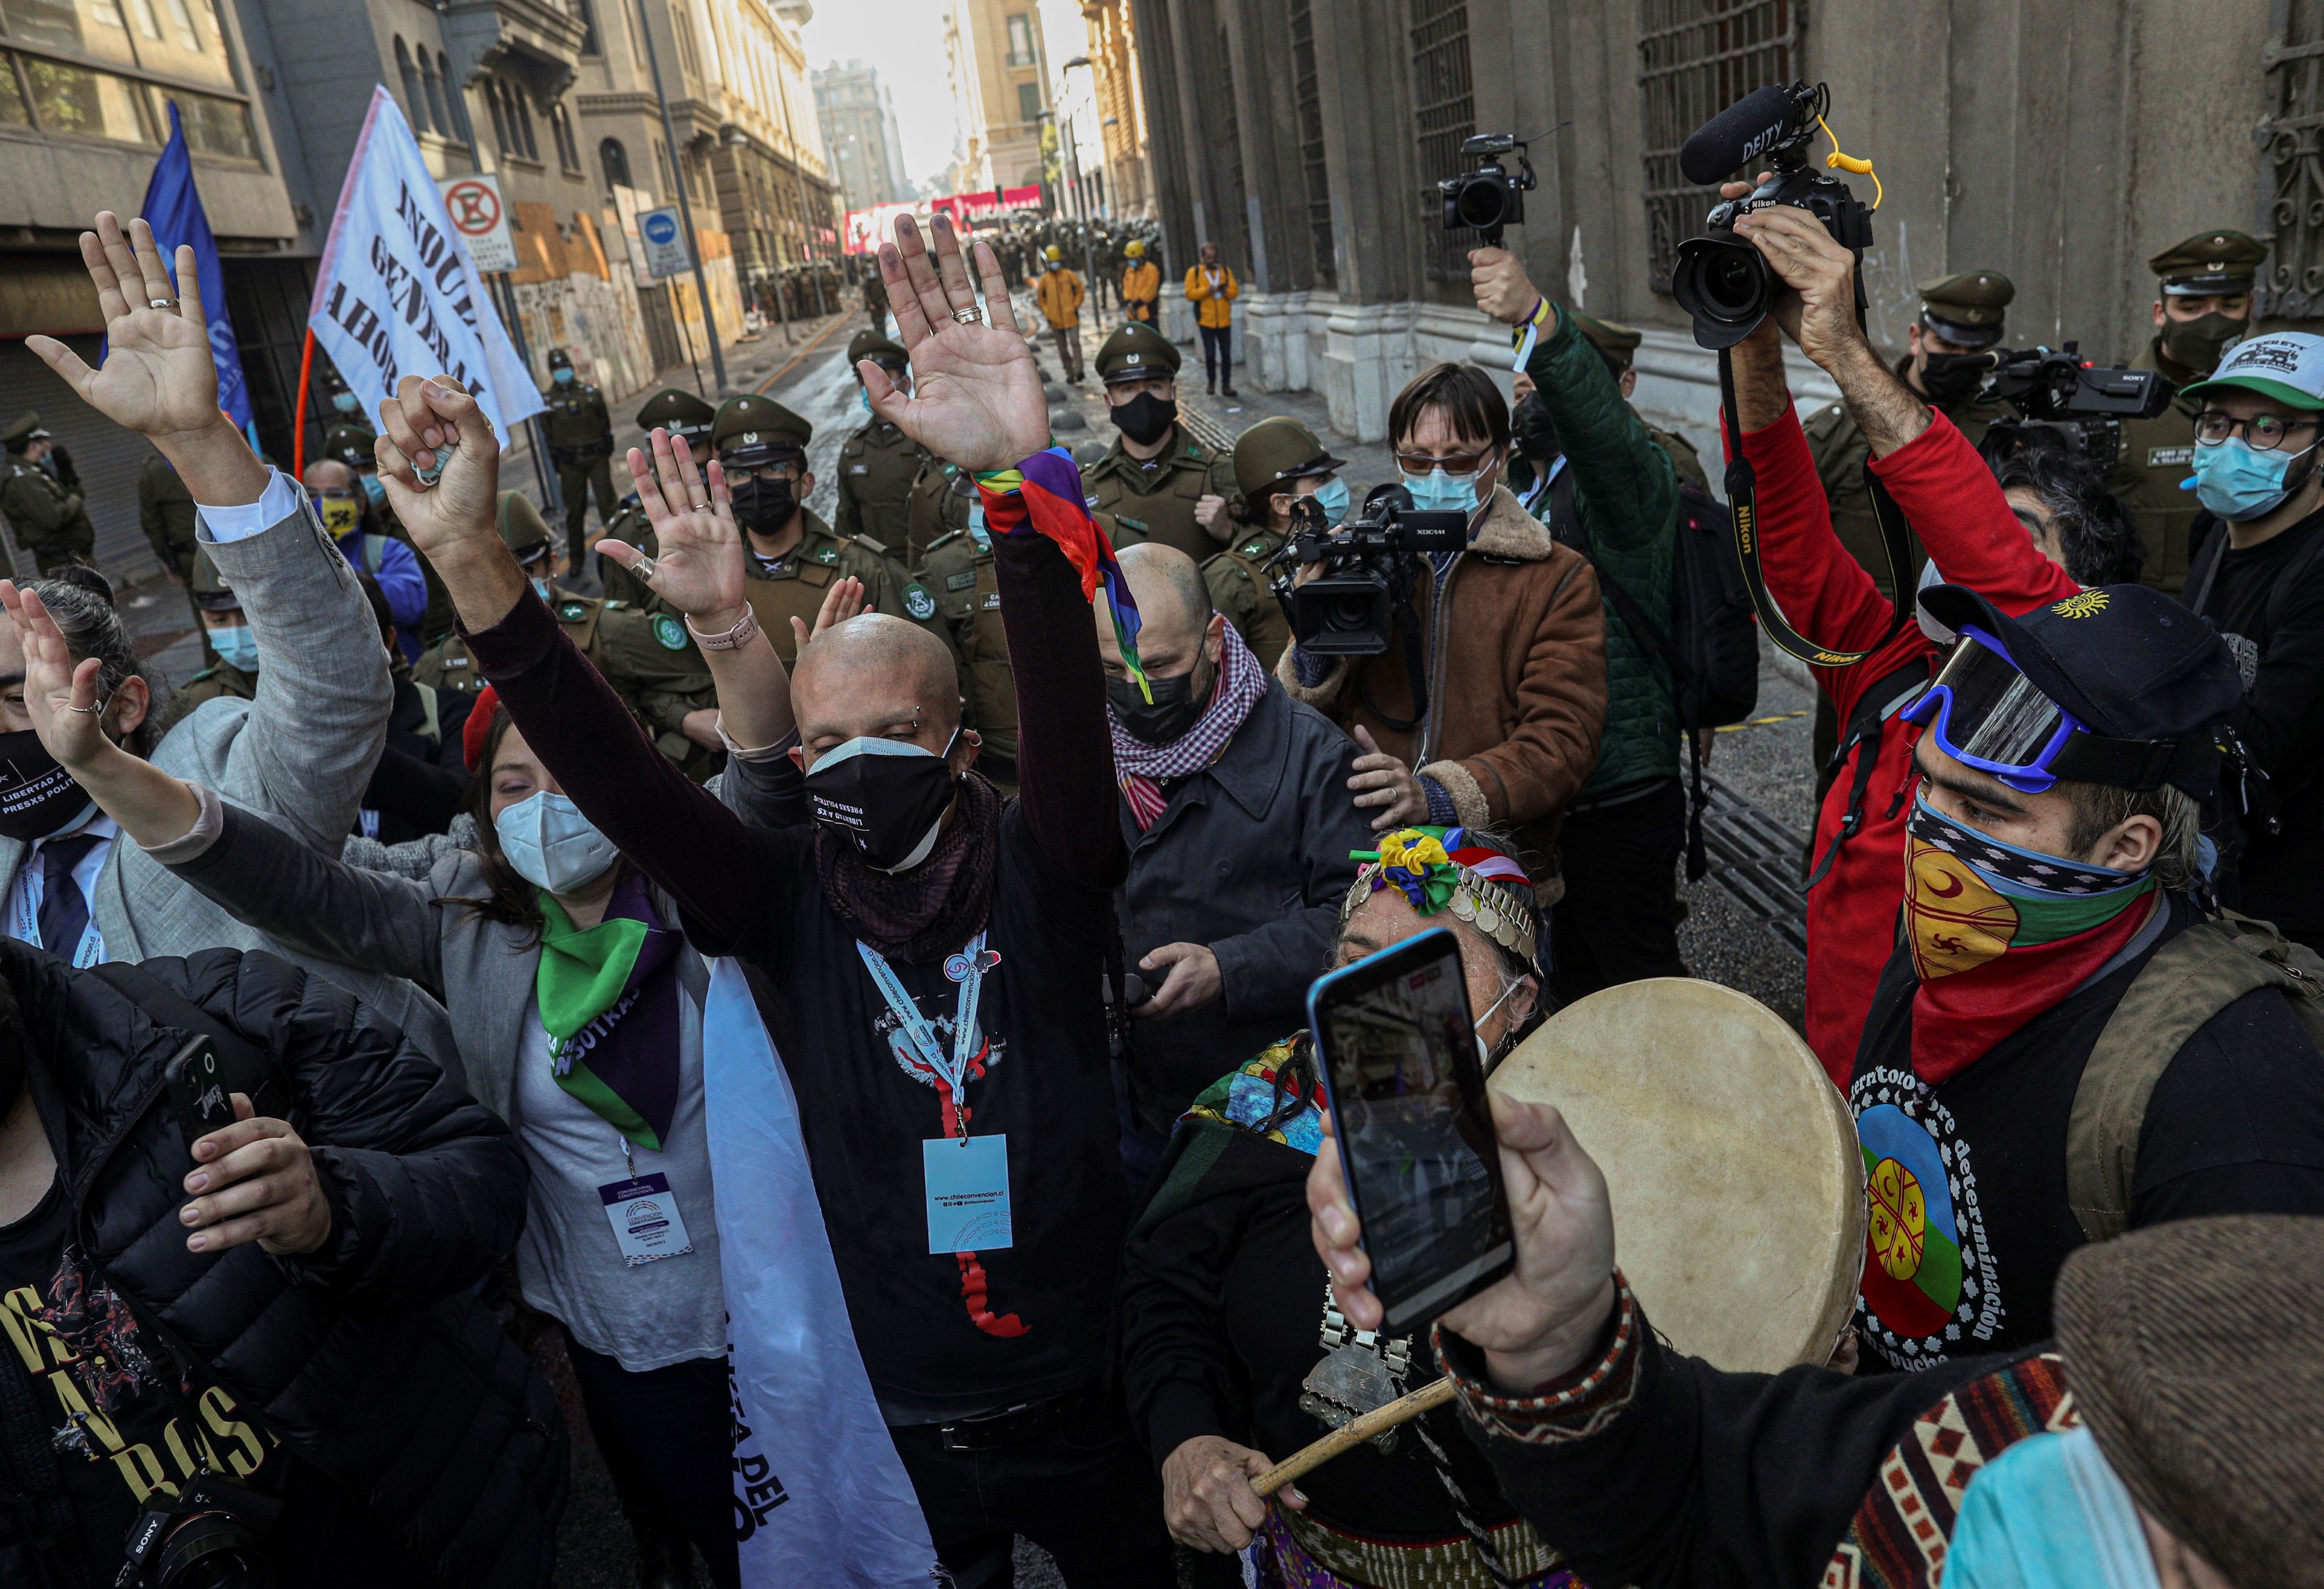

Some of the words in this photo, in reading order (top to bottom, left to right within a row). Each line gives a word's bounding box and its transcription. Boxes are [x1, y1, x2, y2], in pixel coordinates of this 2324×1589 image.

[1742, 120, 1783, 163] DEITY
[396, 179, 484, 349] INDUL
[326, 281, 399, 398] AHOR
[1738, 505, 1751, 555] Nikon
[1812, 652, 1861, 663] Nikon
[3, 776, 54, 803] LIBERTAD
[3, 794, 45, 814] PRESXS
[46, 777, 74, 798] POLÍT
[839, 803, 863, 814] PRESXS
[867, 950, 914, 1021] www.chileconvencion.cl
[961, 966, 977, 1045] www.chileconvencion.
[934, 1190, 1004, 1201] www.chileconvencion.cl
[1954, 1139, 2006, 1341] determinación
[739, 1454, 790, 1527] DEL
[136, 1520, 158, 1554] SONY
